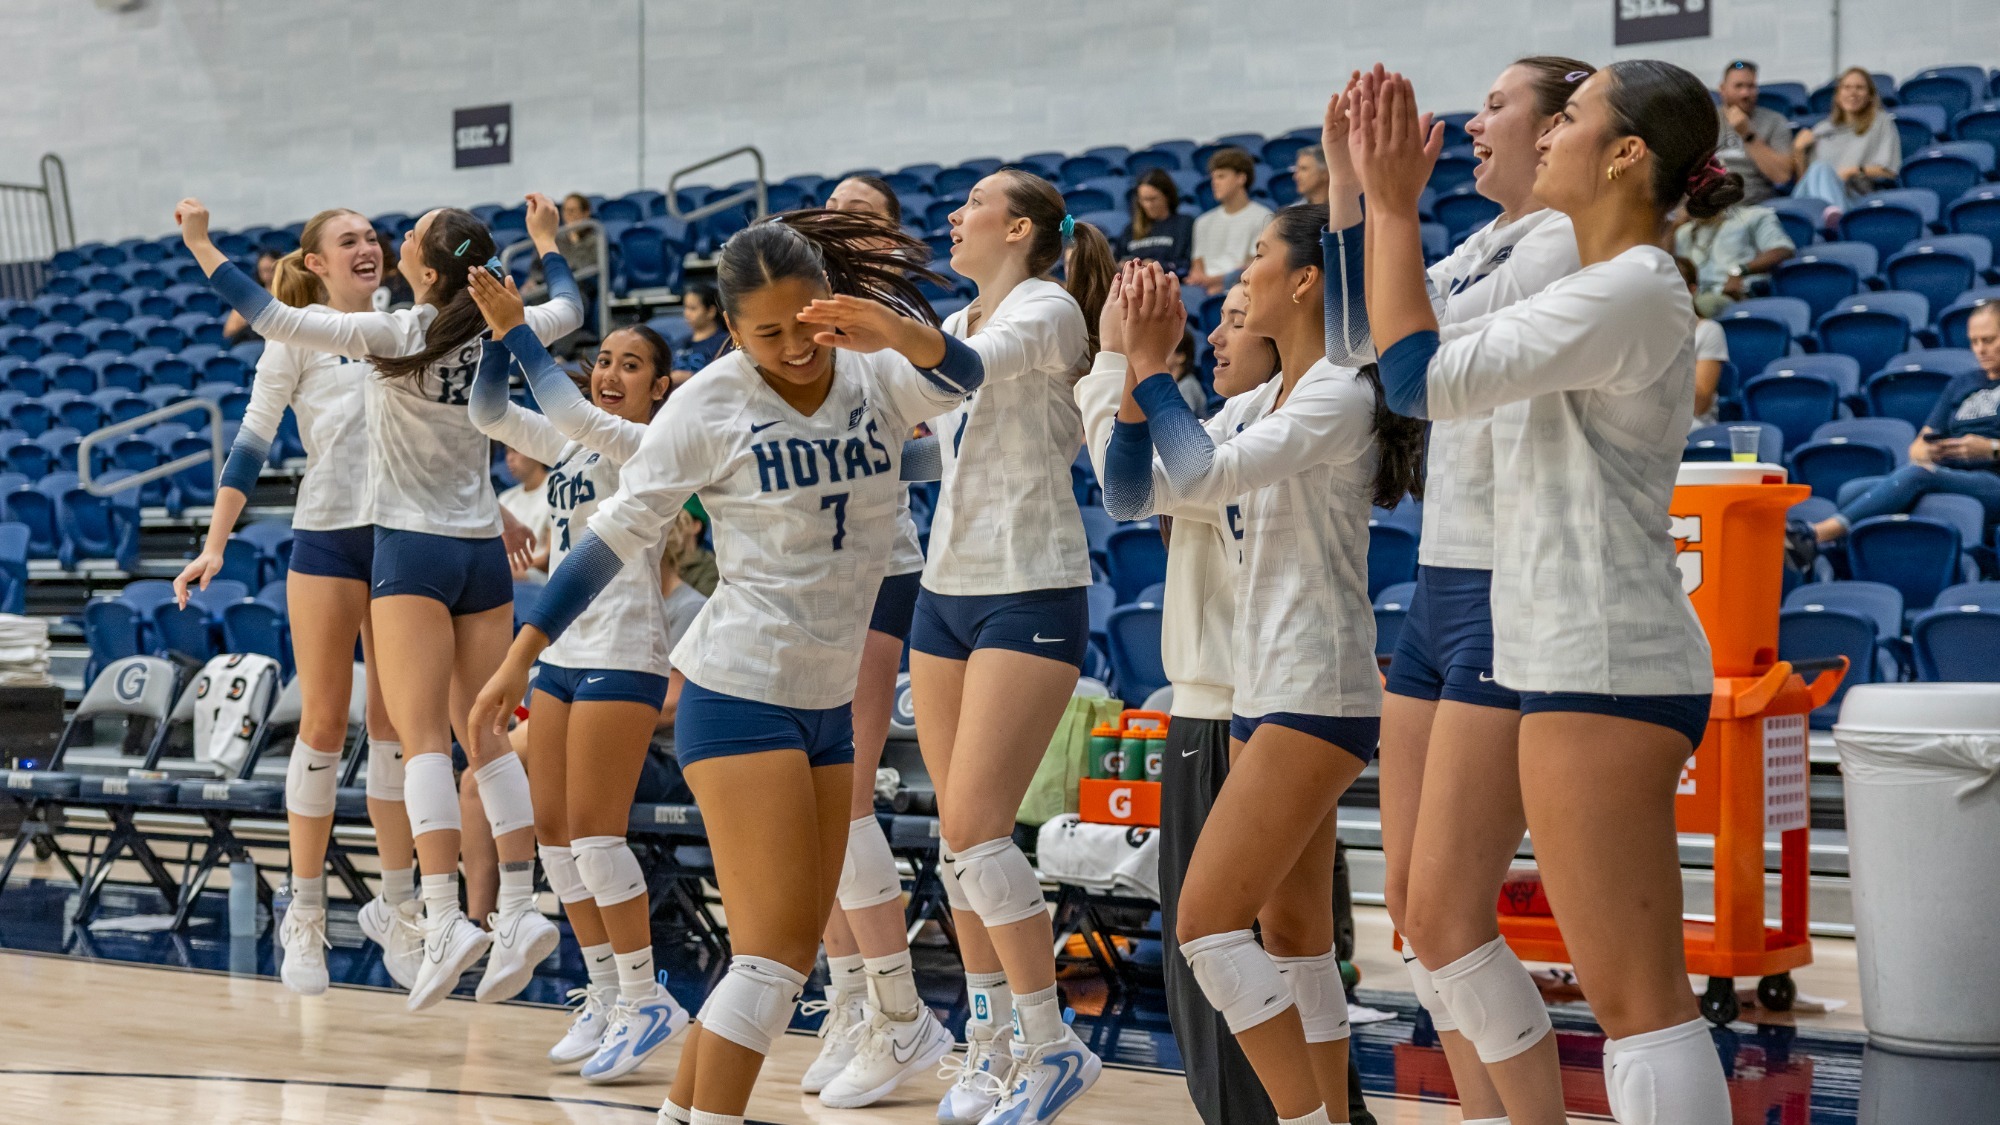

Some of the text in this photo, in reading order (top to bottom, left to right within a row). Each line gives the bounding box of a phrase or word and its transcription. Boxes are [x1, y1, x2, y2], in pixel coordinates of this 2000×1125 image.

[494, 123, 508, 146] 7
[751, 419, 892, 492] HOYAS
[820, 493, 849, 552] 7
[115, 661, 149, 702] G
[1108, 788, 1132, 819] G
